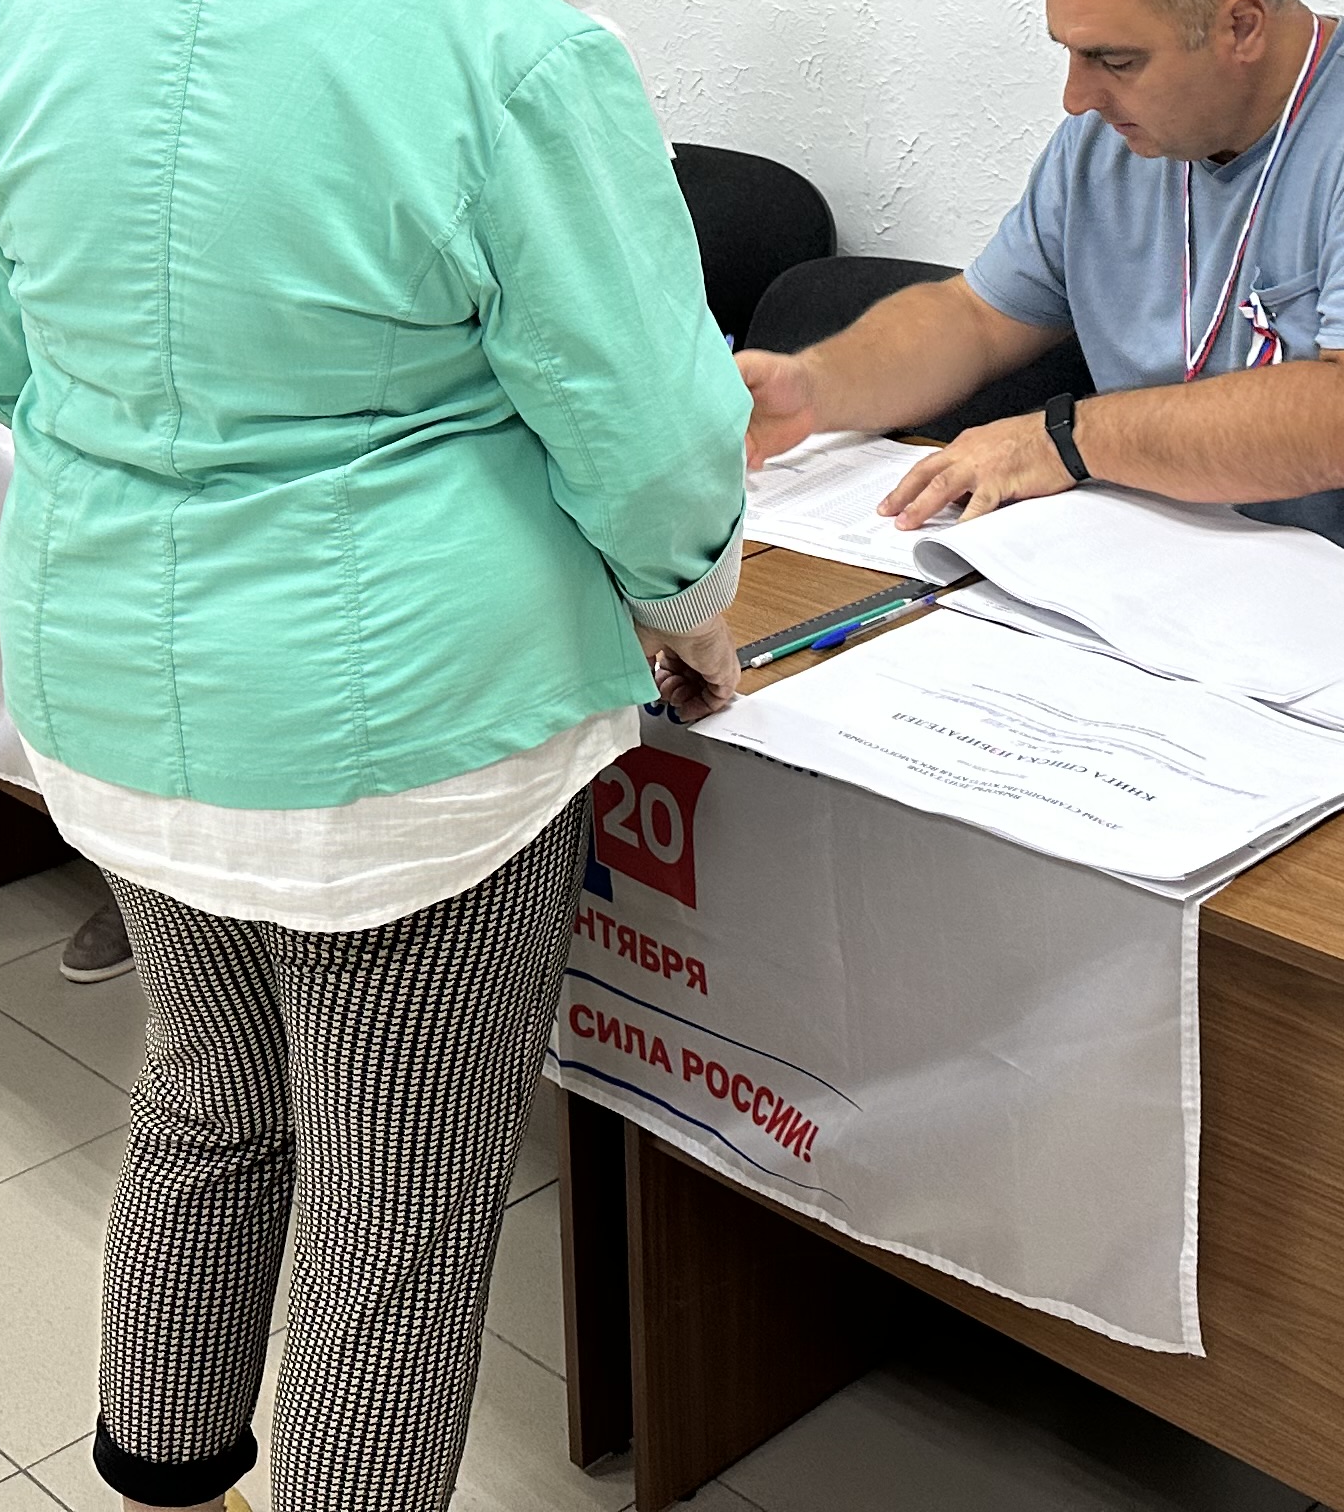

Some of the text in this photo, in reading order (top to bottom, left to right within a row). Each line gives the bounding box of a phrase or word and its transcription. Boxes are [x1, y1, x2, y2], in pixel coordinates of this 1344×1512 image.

[599, 765, 684, 864] 20
[1094, 771, 1158, 802] КНИГА
[573, 907, 708, 995] НТЯБРЯ
[569, 1004, 819, 1163] СИЛА РОССИИ!
